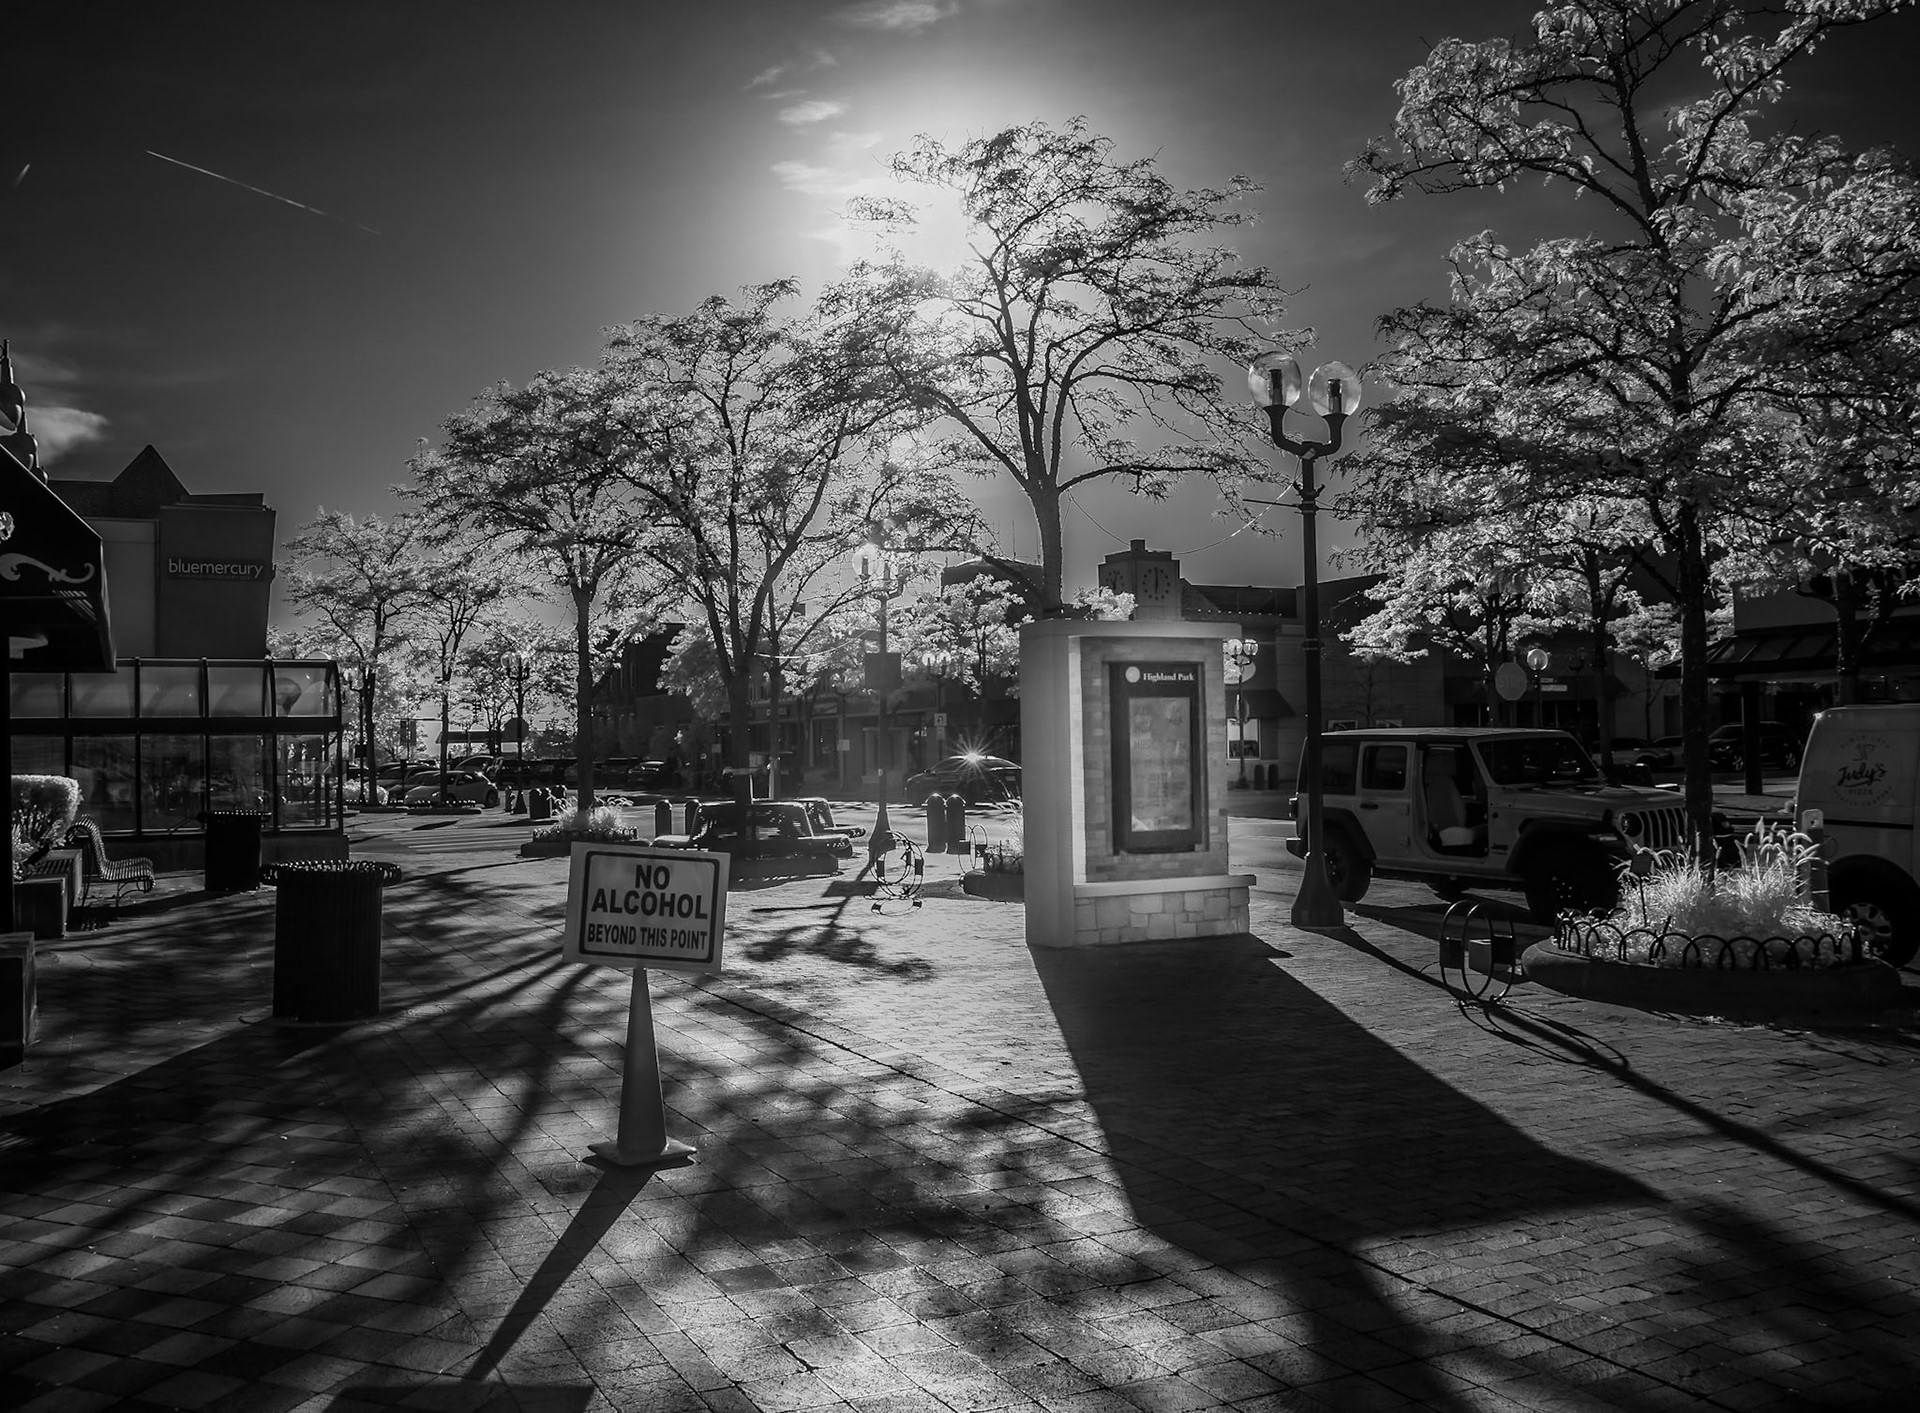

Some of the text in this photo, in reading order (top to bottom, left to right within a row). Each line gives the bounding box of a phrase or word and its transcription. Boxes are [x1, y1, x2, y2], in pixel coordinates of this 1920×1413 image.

[168, 558, 263, 578] bluemercury
[1143, 672, 1195, 683] Highland Park
[1837, 761, 1887, 787] Judy's
[635, 864, 670, 890] NO
[591, 888, 708, 919] ALCOHOL
[587, 923, 708, 950] BEYOND THIS POINT
